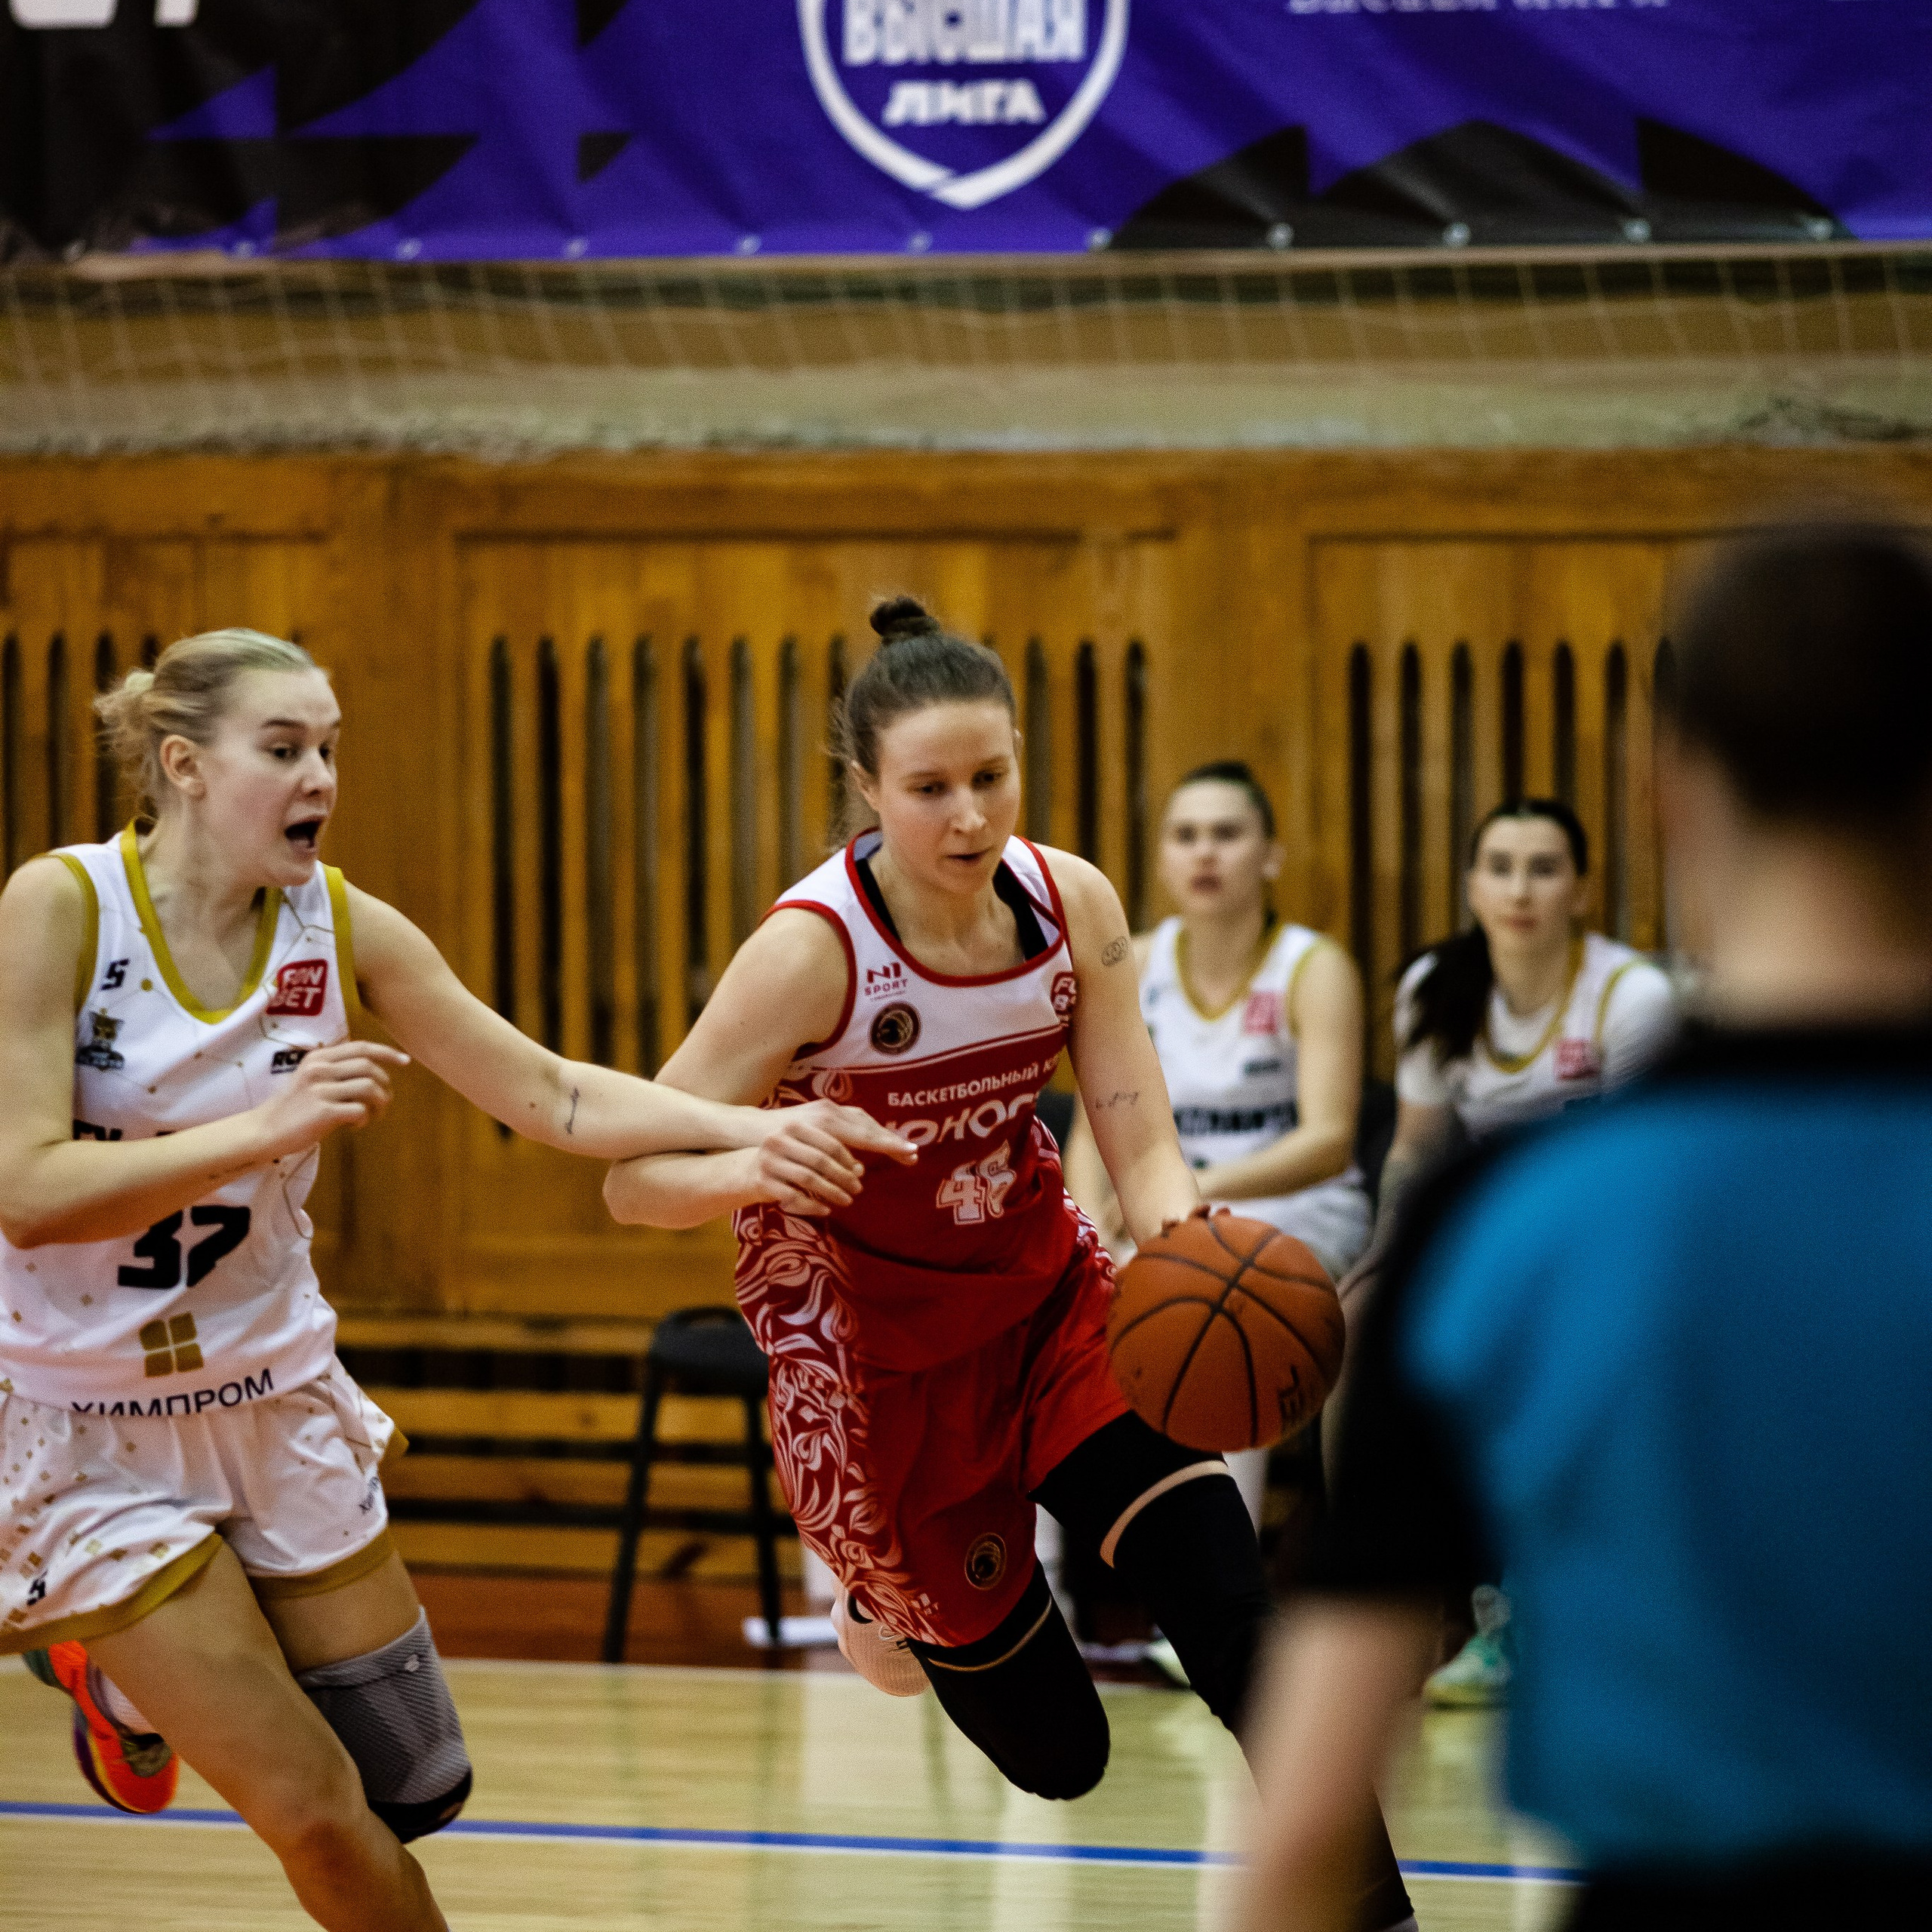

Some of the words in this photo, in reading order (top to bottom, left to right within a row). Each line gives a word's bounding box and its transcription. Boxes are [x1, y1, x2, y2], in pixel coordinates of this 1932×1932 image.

[881, 78, 1049, 127] ЛИГА
[864, 978, 908, 996] SPORT
[887, 1061, 1039, 1107] БАСКЕТБОЛЬНЫЙ
